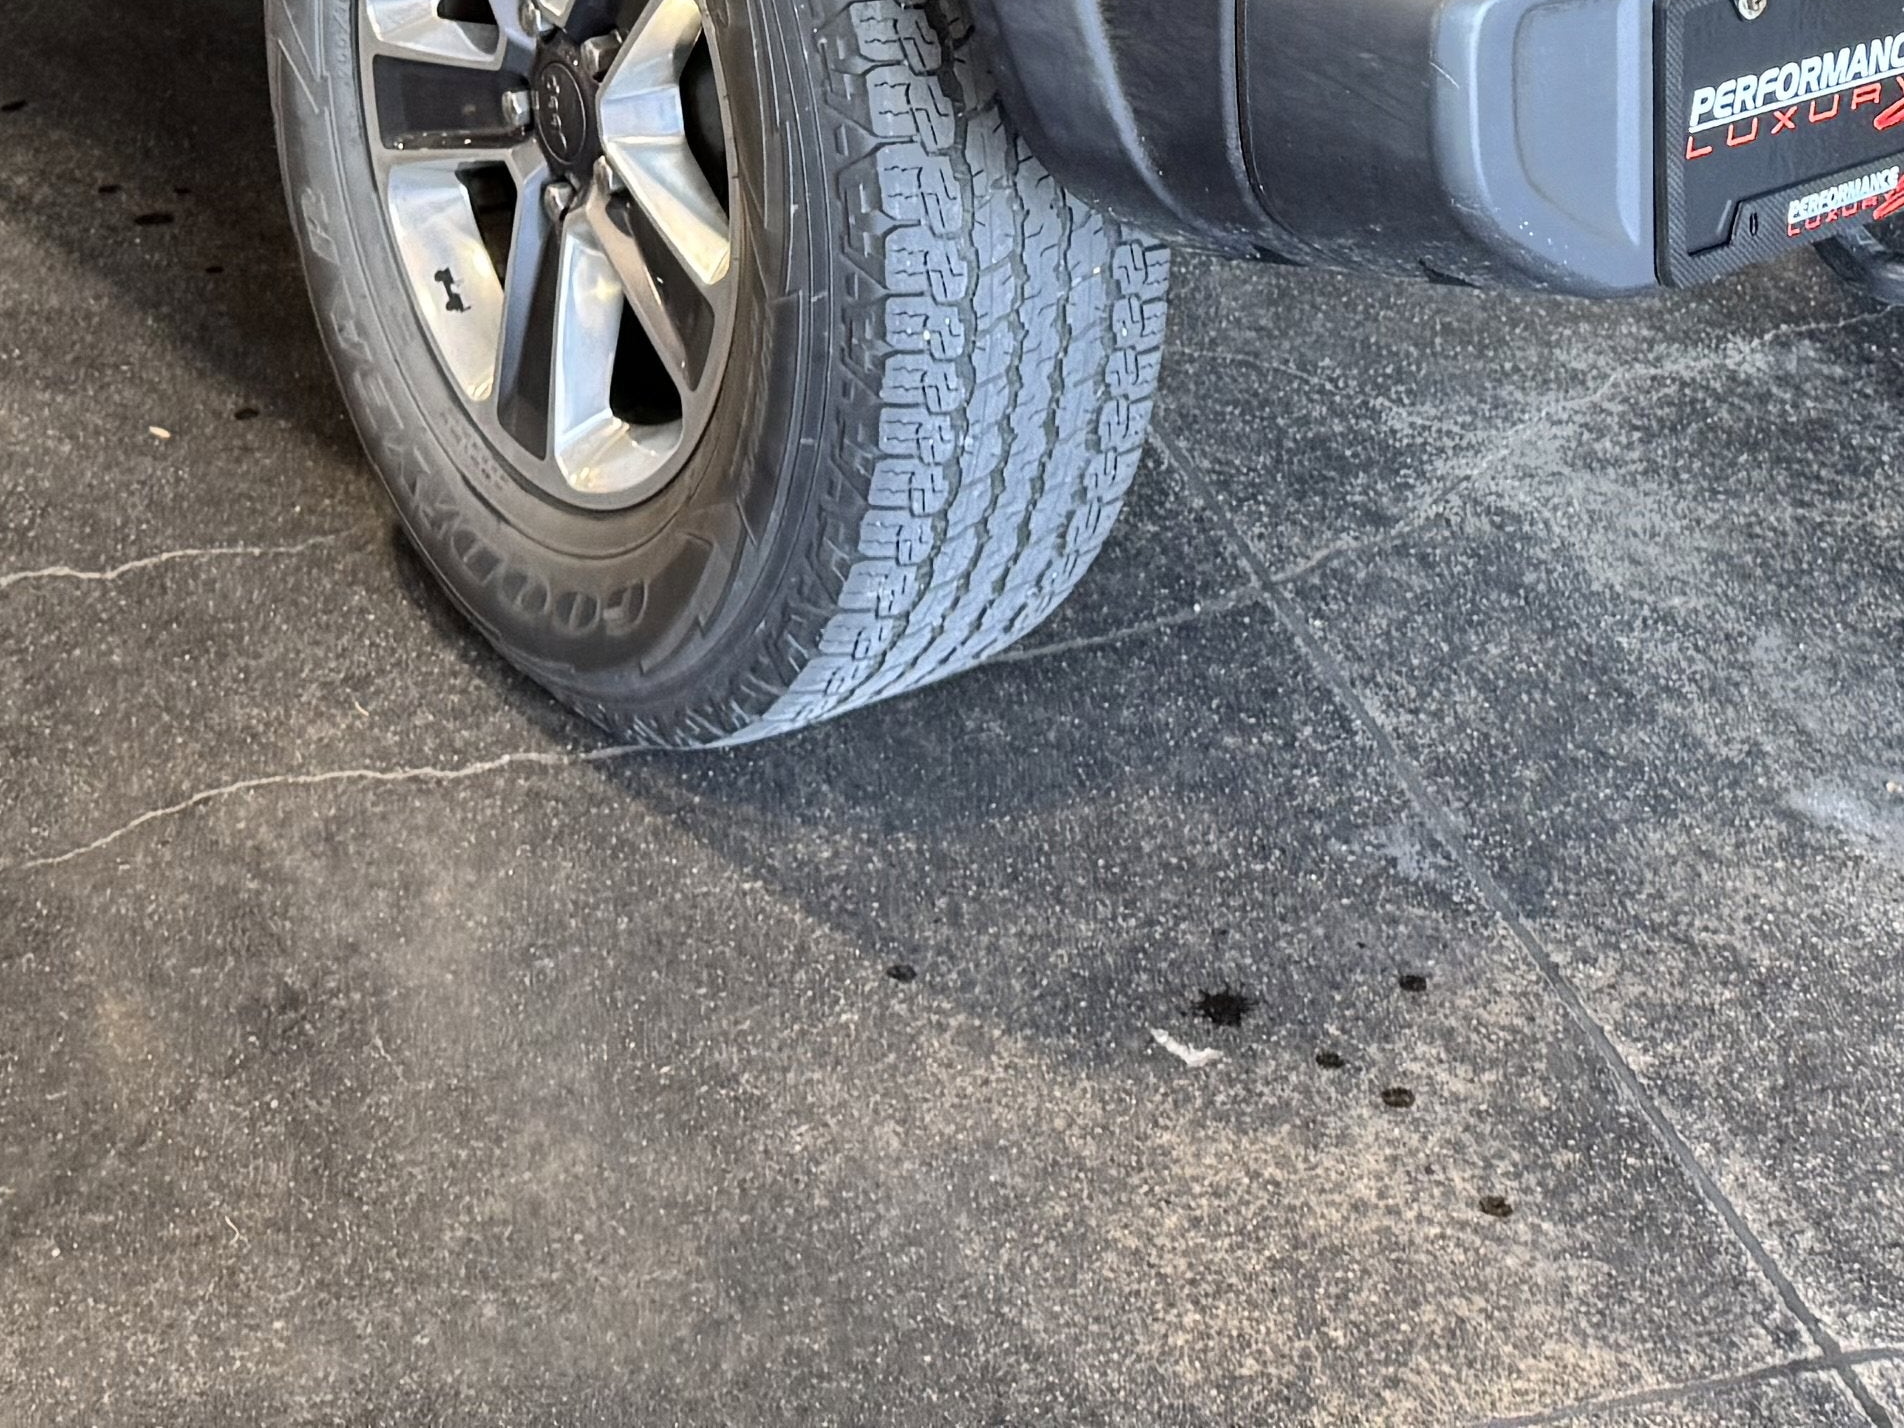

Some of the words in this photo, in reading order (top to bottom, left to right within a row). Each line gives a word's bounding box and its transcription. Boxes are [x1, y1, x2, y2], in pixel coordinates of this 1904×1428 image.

[1787, 190, 1895, 238] LUXURY
[1788, 165, 1900, 224] PERFORMANCE
[300, 186, 651, 636] GOODYEAR
